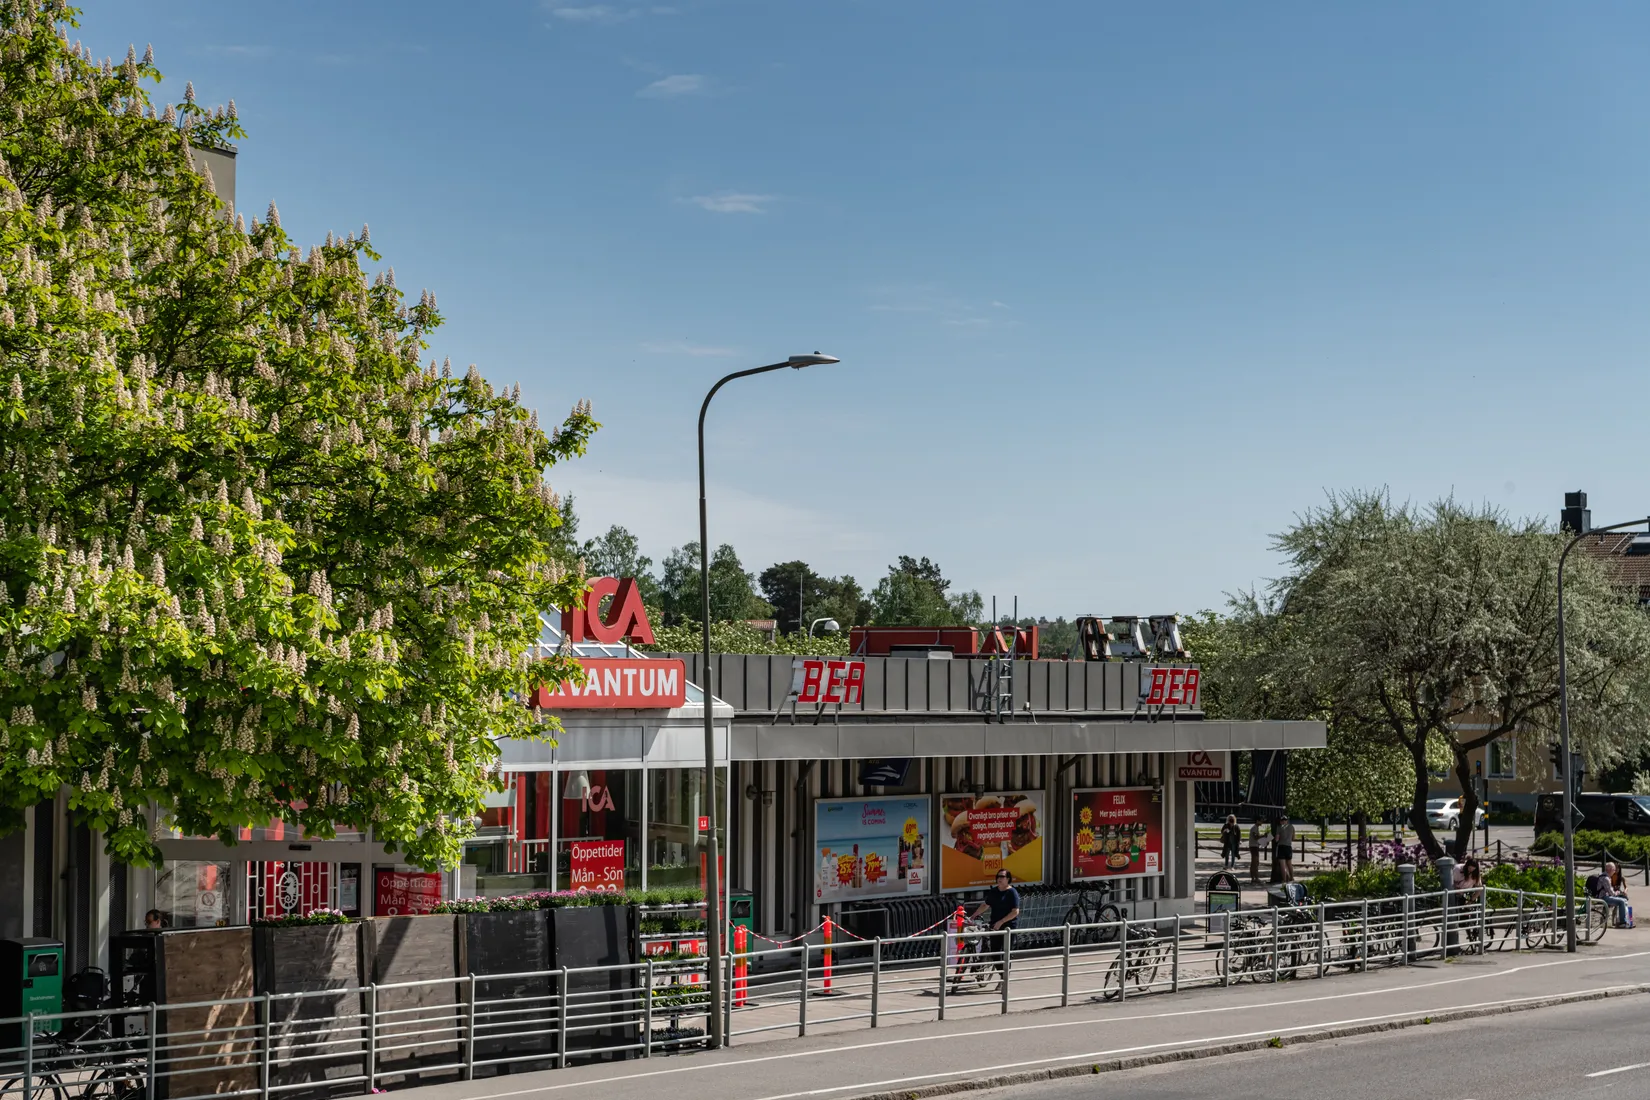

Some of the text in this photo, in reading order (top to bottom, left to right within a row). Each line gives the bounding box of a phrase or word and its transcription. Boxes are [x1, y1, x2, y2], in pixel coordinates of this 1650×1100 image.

[561, 577, 656, 644] ICA
[797, 660, 866, 704] BEA
[1146, 668, 1200, 705] BEA
[1187, 752, 1212, 766] ICA
[1180, 768, 1220, 777] KVANTUM
[582, 785, 616, 813] ICA
[1112, 795, 1126, 805] FELIX
[968, 812, 988, 821] Ovanligt
[572, 843, 623, 862] Öppettider
[381, 875, 438, 889] Öppettider
[571, 867, 595, 883] Mån
[603, 866, 623, 881] Sön
[910, 871, 919, 879] ICA
